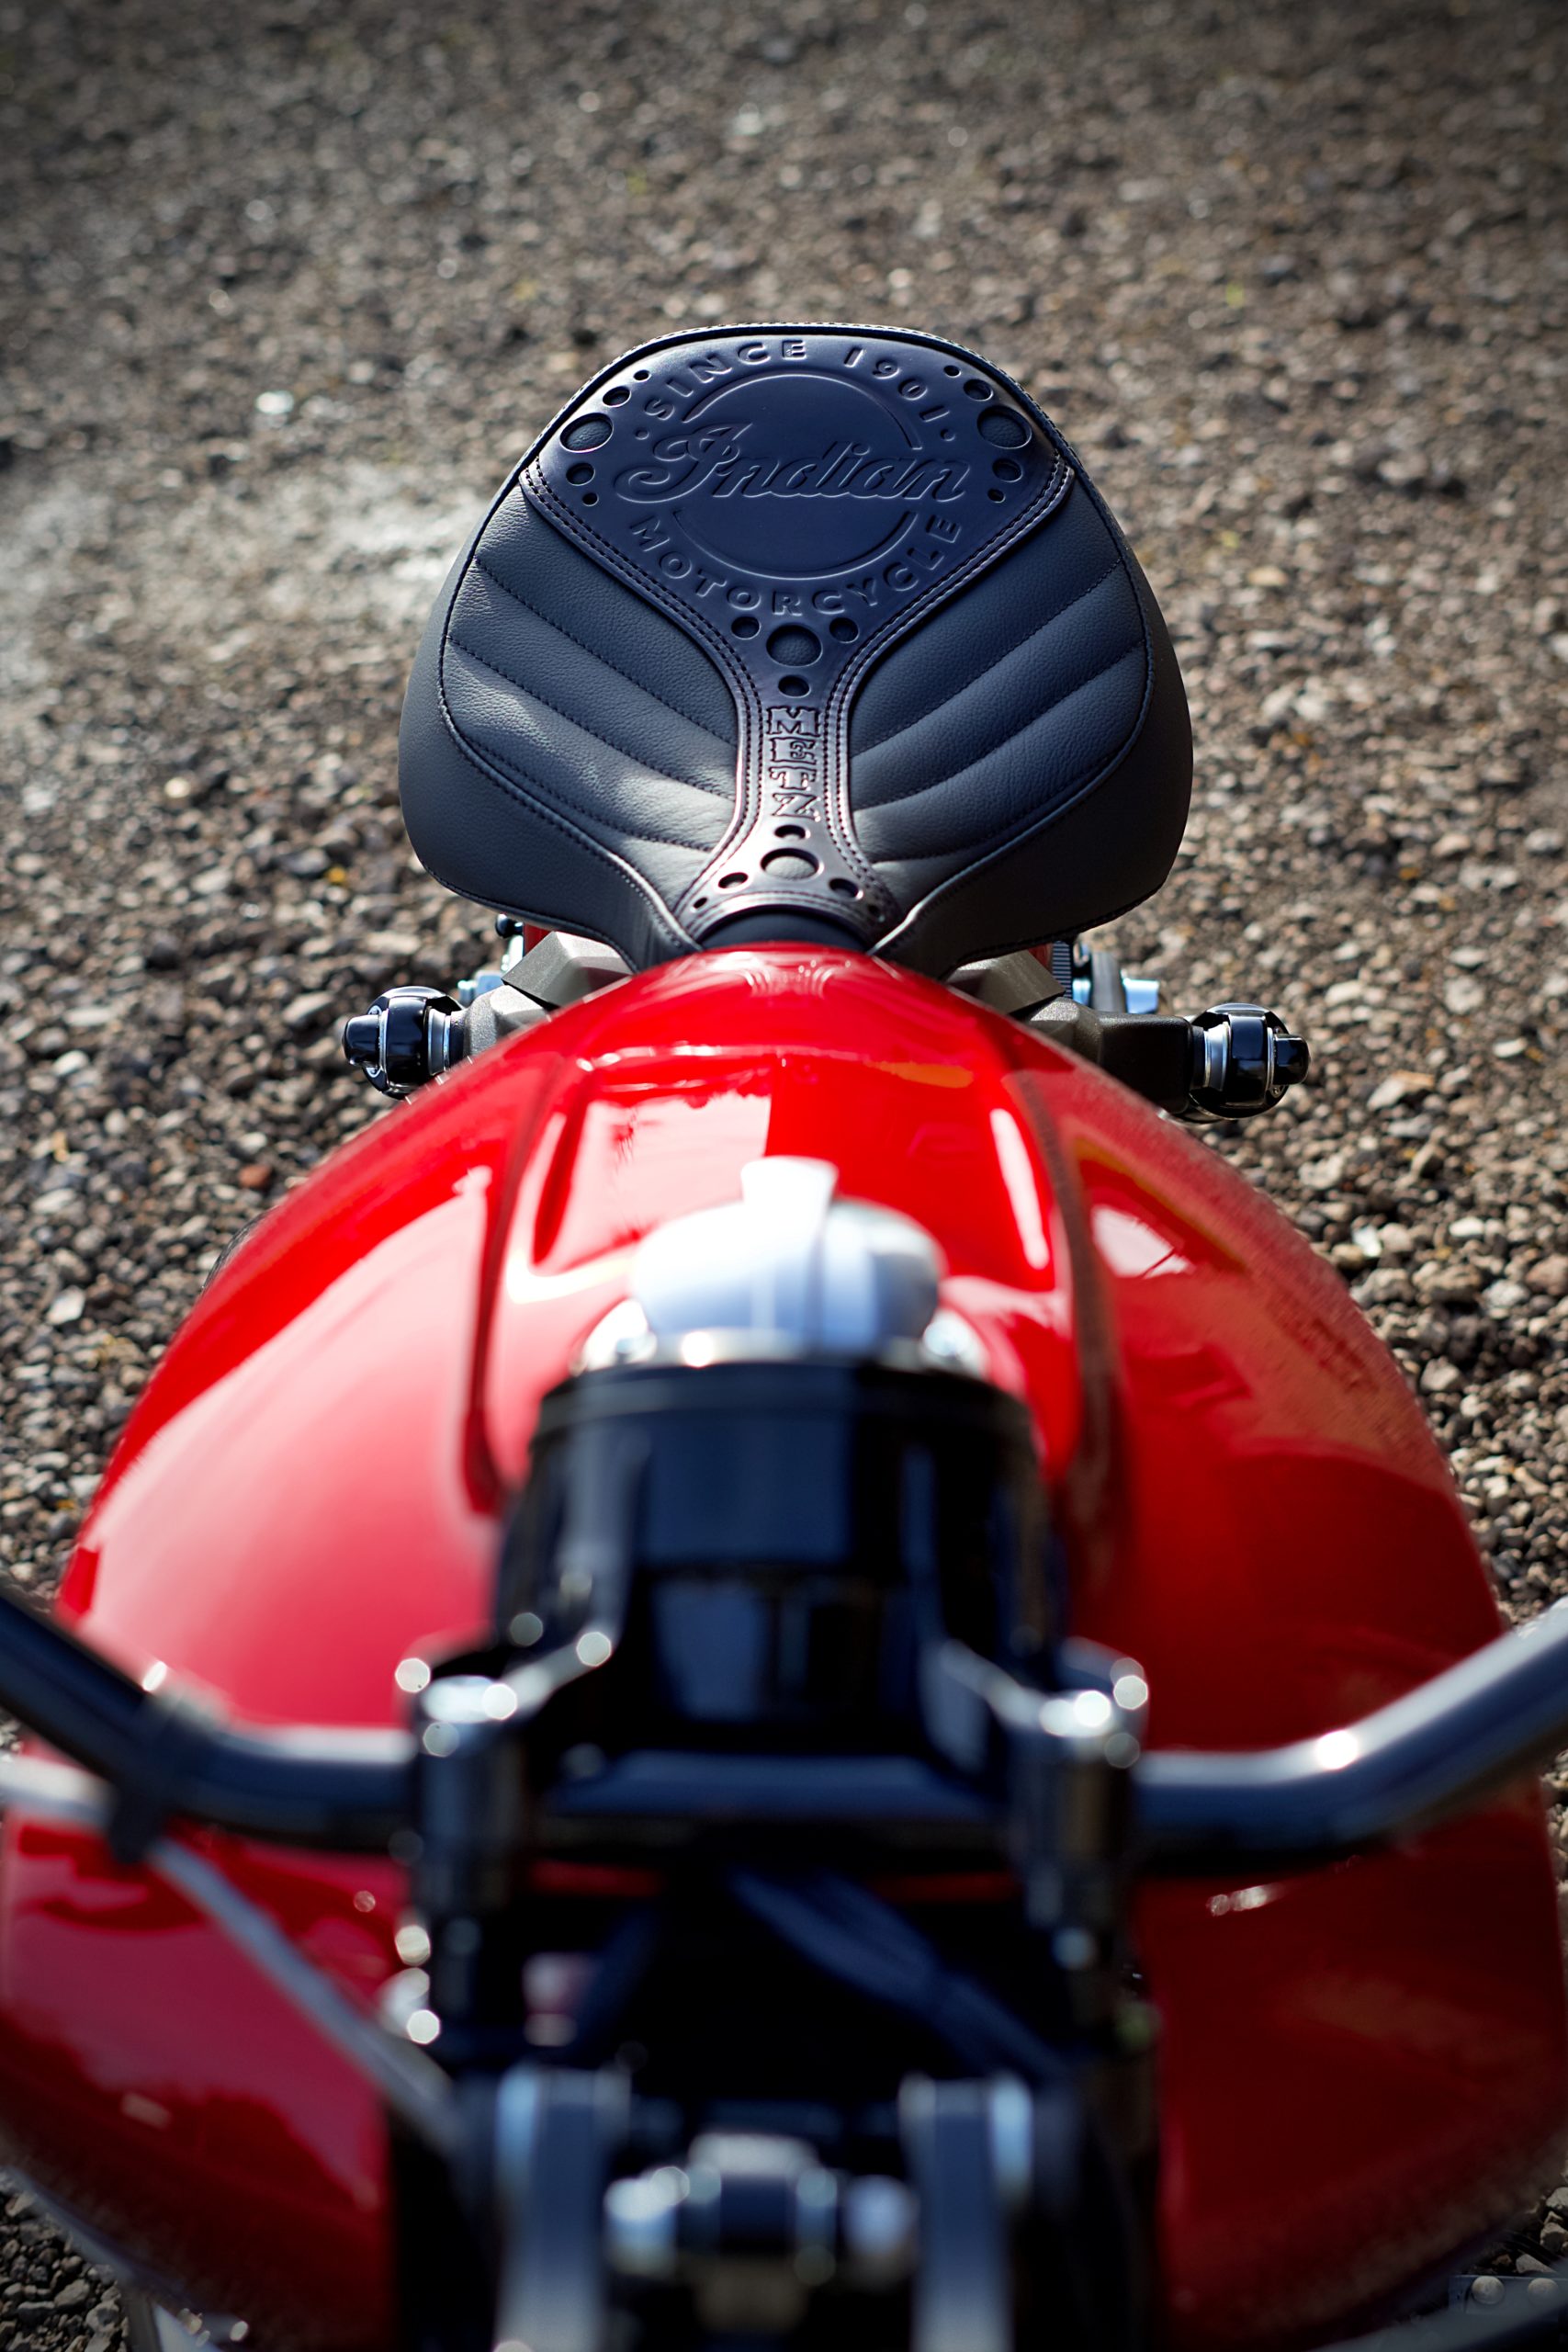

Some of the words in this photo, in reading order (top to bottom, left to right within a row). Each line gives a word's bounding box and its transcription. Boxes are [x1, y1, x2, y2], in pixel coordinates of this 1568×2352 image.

[644, 338, 807, 423] SINCE
[613, 420, 972, 503] Indian
[628, 513, 963, 617] MOTORCYCLE
[765, 706, 820, 820] METZ
